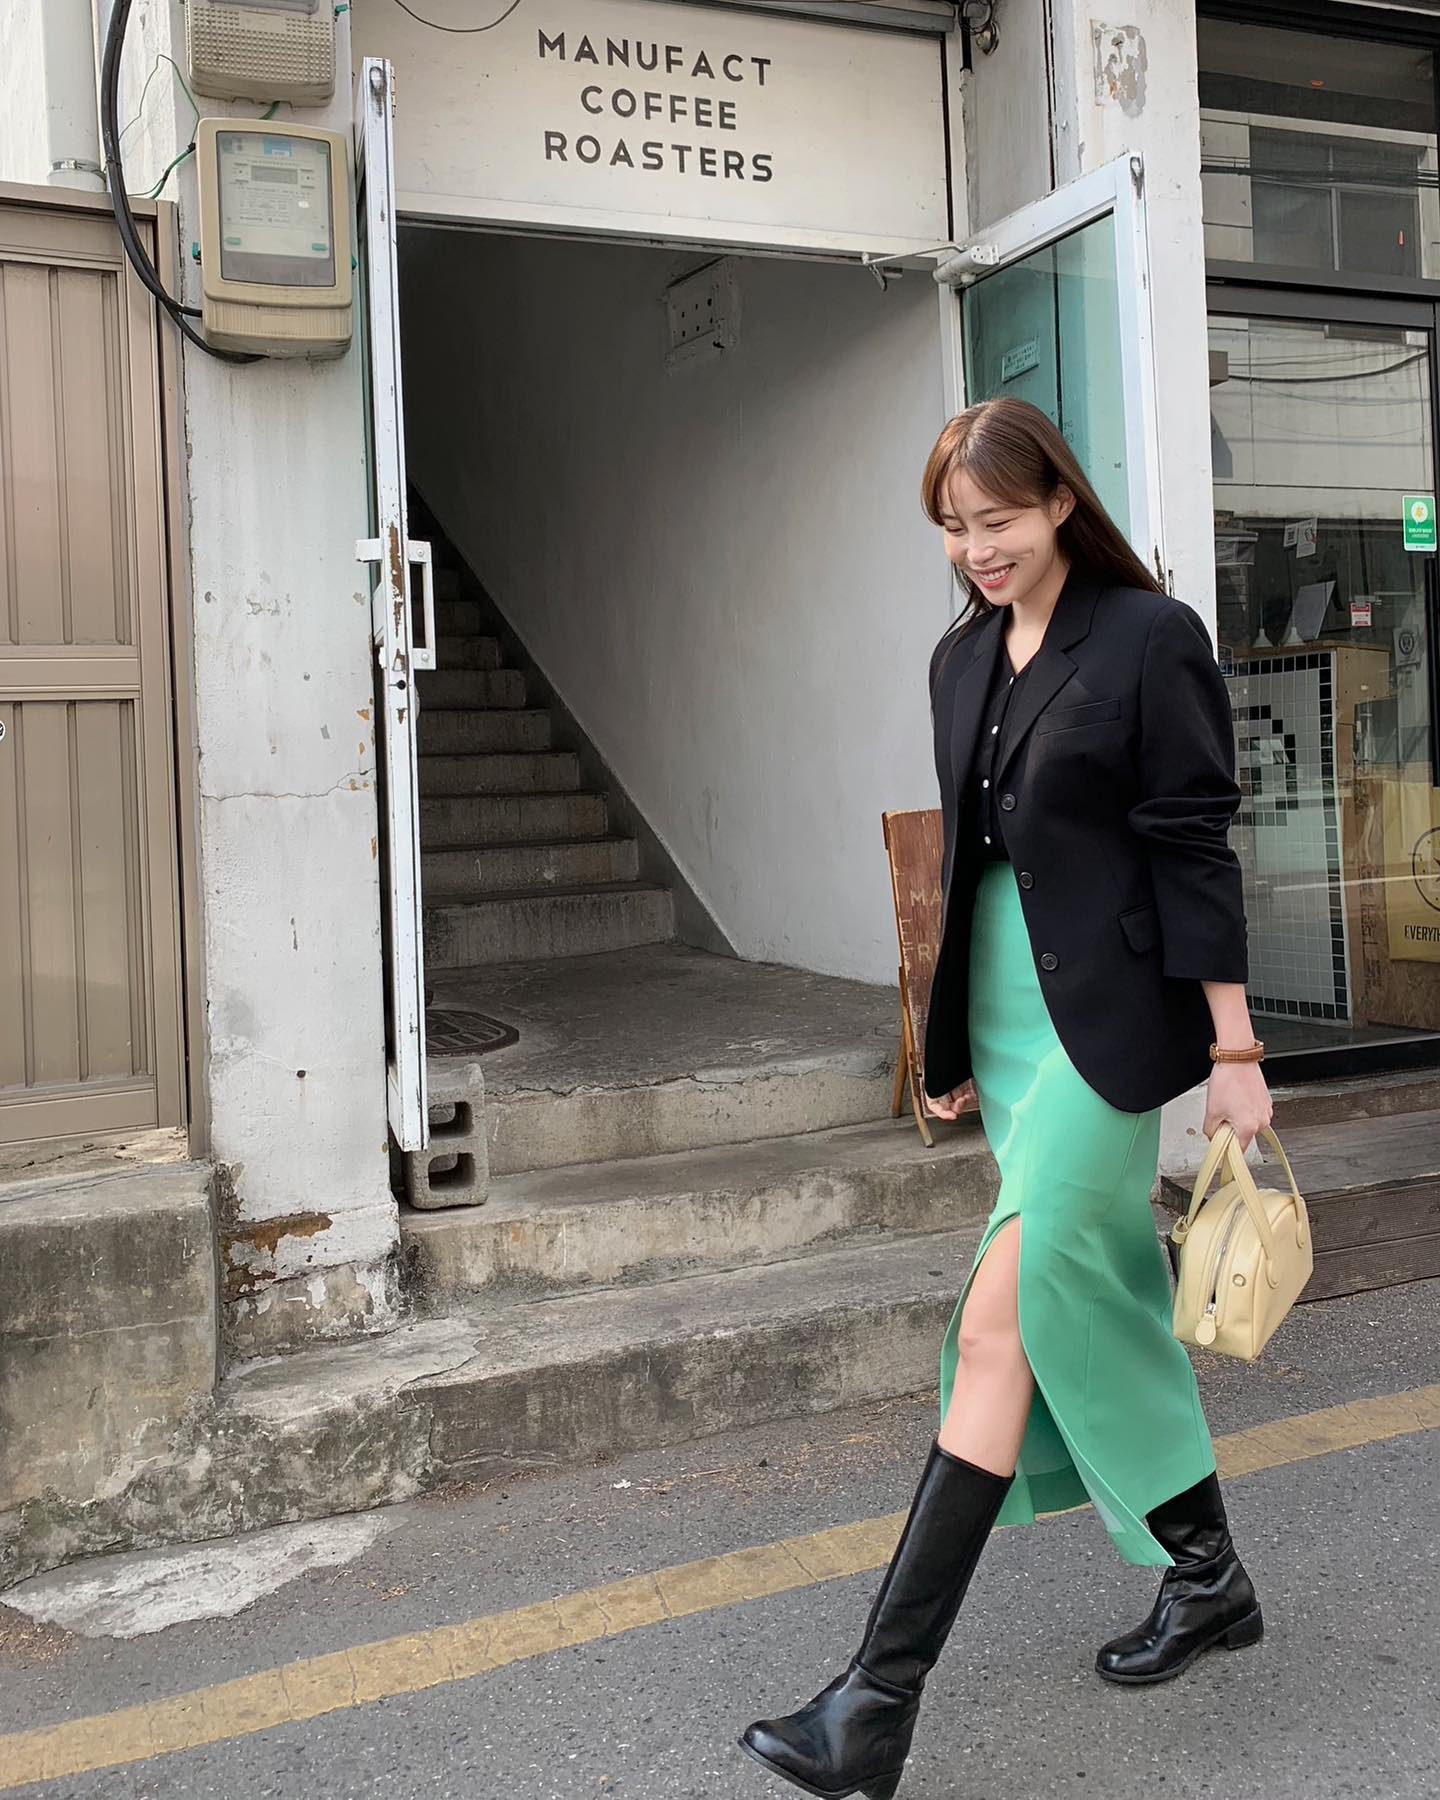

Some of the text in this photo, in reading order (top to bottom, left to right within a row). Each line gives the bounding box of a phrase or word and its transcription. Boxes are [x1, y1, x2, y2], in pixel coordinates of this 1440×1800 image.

[537, 28, 772, 86] MANUFACT
[580, 85, 737, 131] COFFEE
[544, 130, 773, 182] ROASTERS
